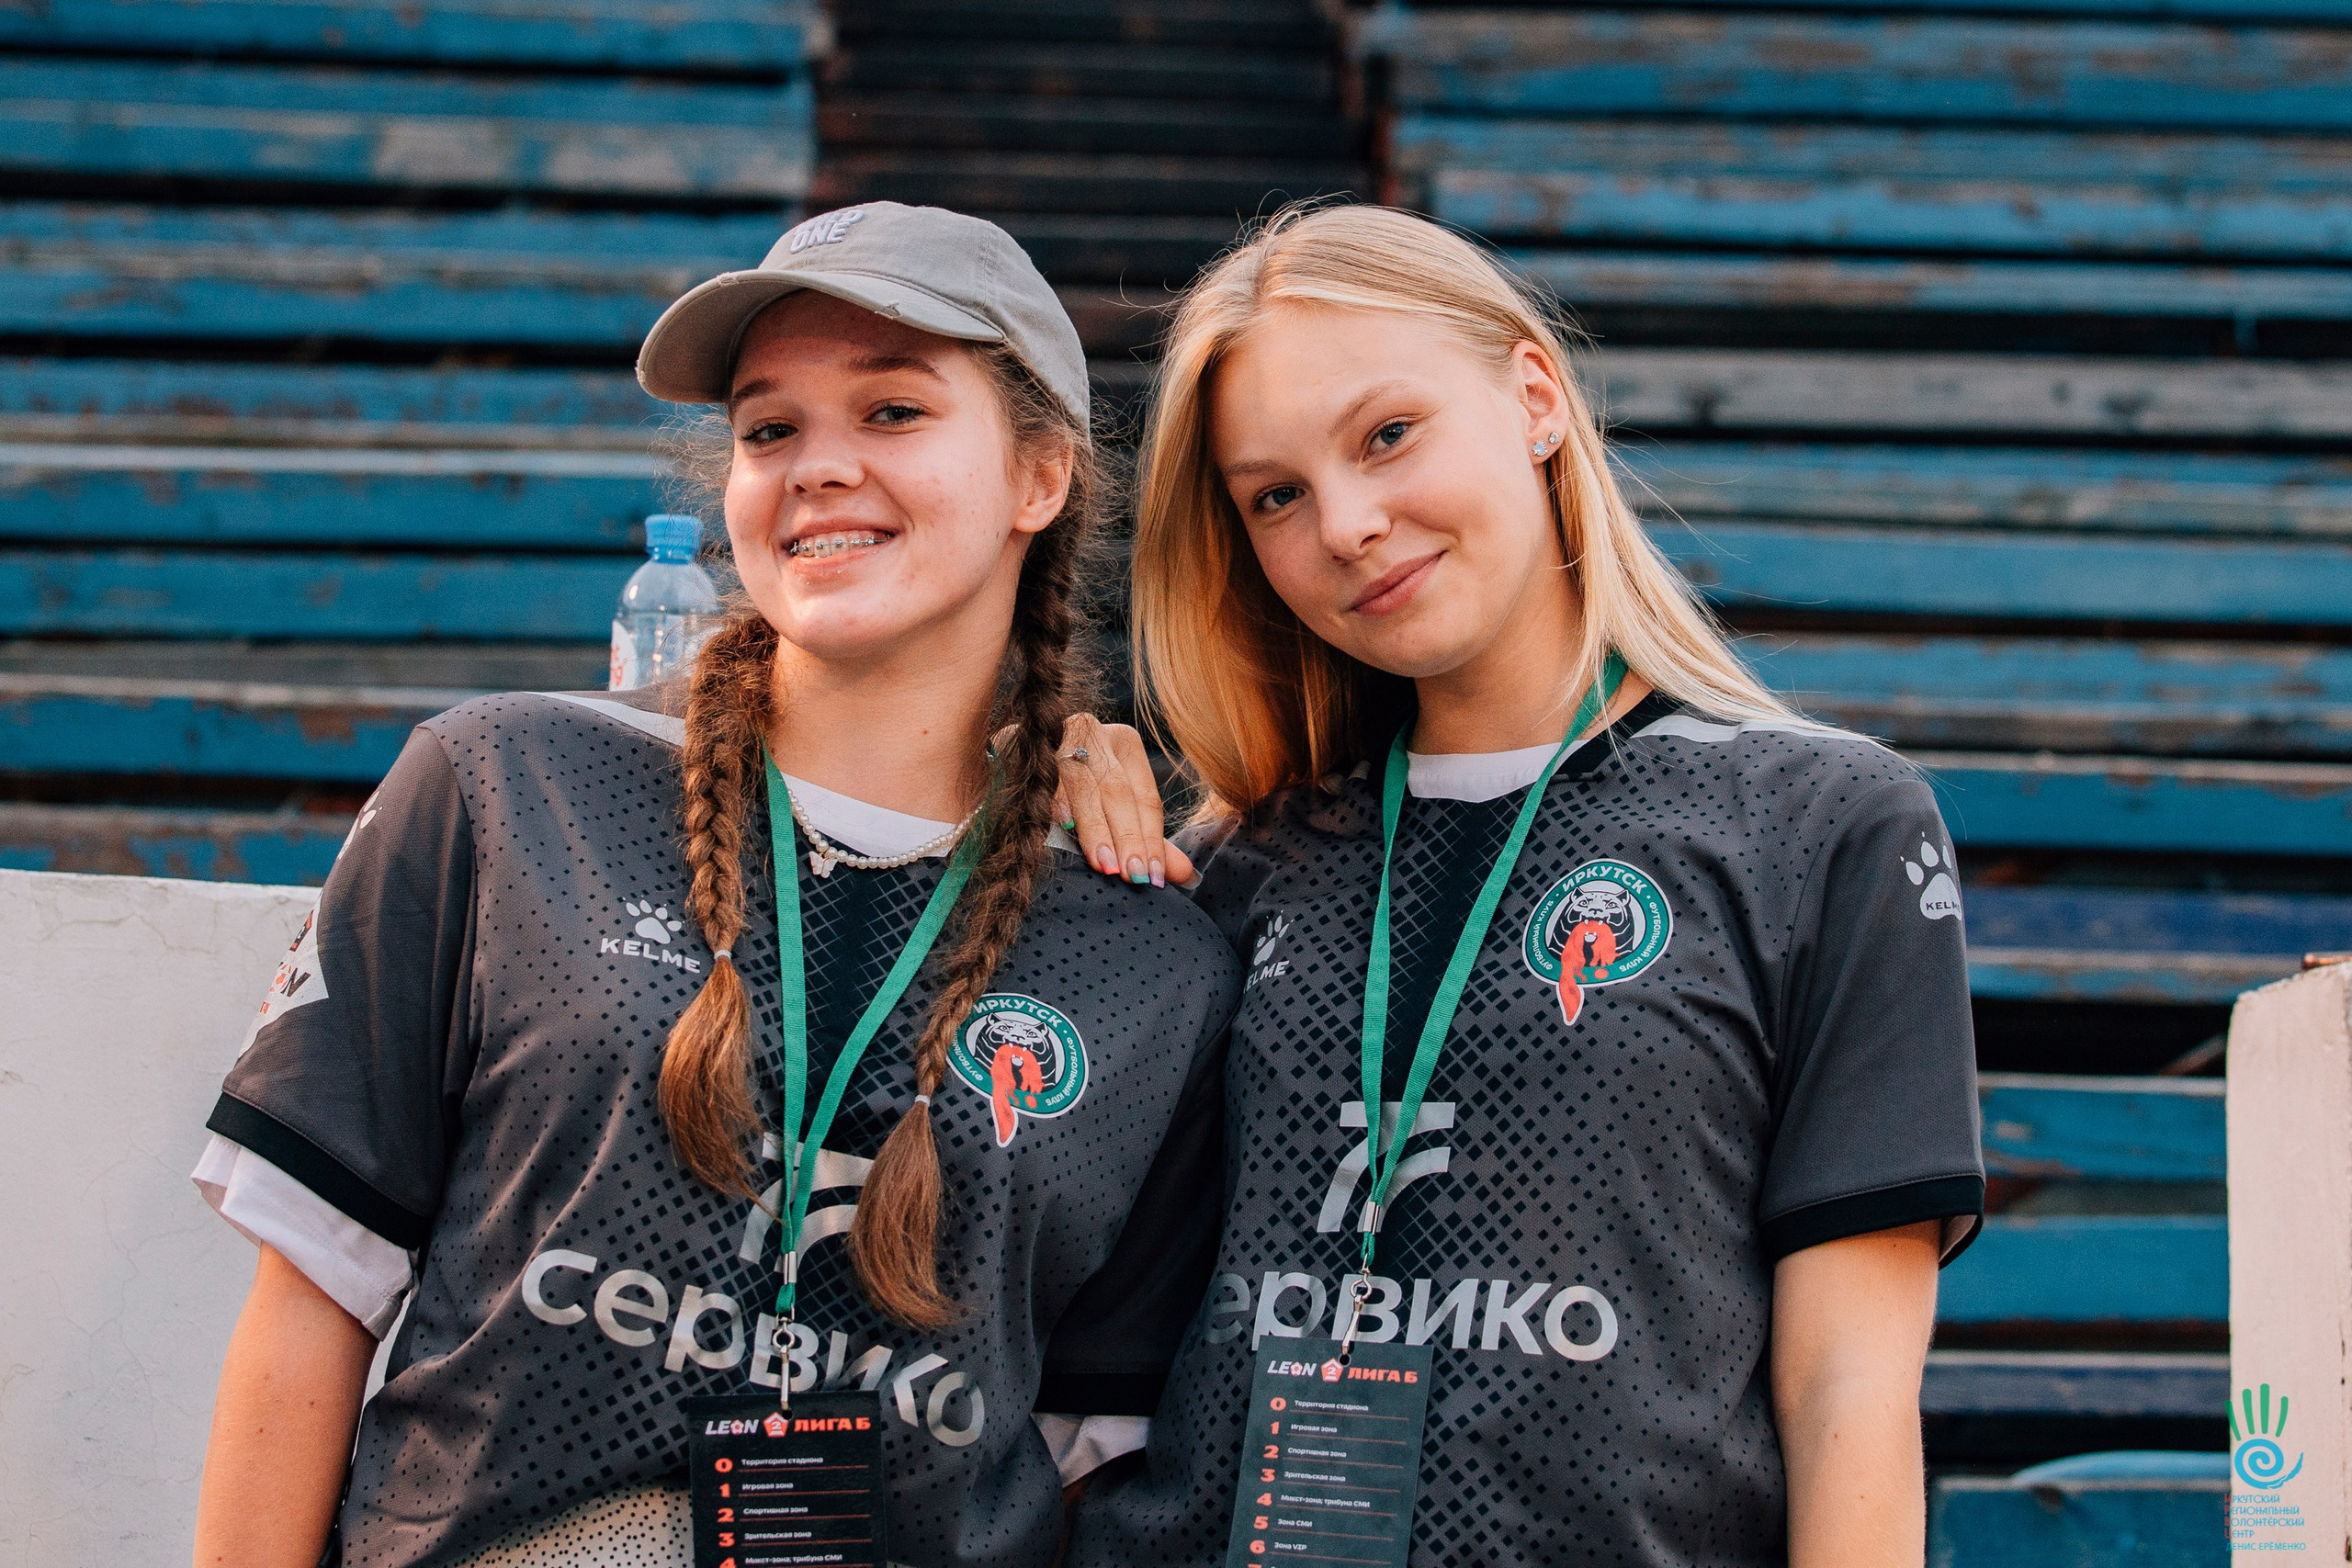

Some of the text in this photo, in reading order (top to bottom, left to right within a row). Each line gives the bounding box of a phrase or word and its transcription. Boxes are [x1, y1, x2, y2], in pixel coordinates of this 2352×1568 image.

[790, 221, 851, 254] ONE
[1562, 865, 1647, 895] ИРКУТСК
[1532, 900, 1554, 970] ФУТБОЛЬНЫЙ КЛУБ
[1619, 901, 1661, 972] ФУТБОЛЬНЫЙ КЛУБ
[600, 938, 700, 974] KELME
[1243, 960, 1290, 994] ELME
[973, 998, 1063, 1029] ИРКУТСК
[1045, 1036, 1078, 1106] ФУТБОЛЬНЫЙ КЛУБ
[1201, 1270, 1618, 1361] ервико
[1267, 1360, 1317, 1376] LEON
[1348, 1367, 1419, 1384] ЛИГА Б
[1270, 1397, 1286, 1411] 0
[1295, 1400, 1336, 1409] Территория
[705, 1419, 759, 1436] LEON
[794, 1417, 871, 1432] ЛИГА Б
[1271, 1421, 1280, 1435] 1
[1263, 1445, 1279, 1460] 2
[1287, 1447, 1329, 1456] Спортивная
[715, 1458, 733, 1473] 0
[1260, 1469, 1275, 1483] 3
[1284, 1471, 1329, 1481] Зрительская
[719, 1483, 730, 1498] 1
[742, 1483, 775, 1491] Игровая
[1256, 1493, 1272, 1506] 4
[1324, 1498, 1352, 1506] трибуна
[718, 1507, 734, 1522] 2
[1254, 1516, 1269, 1530] 5
[1295, 1519, 1313, 1528] СМИ
[718, 1532, 735, 1547] 3
[744, 1532, 793, 1540] Зрительская
[1250, 1540, 1266, 1554] 6
[718, 1557, 737, 1568] 4
